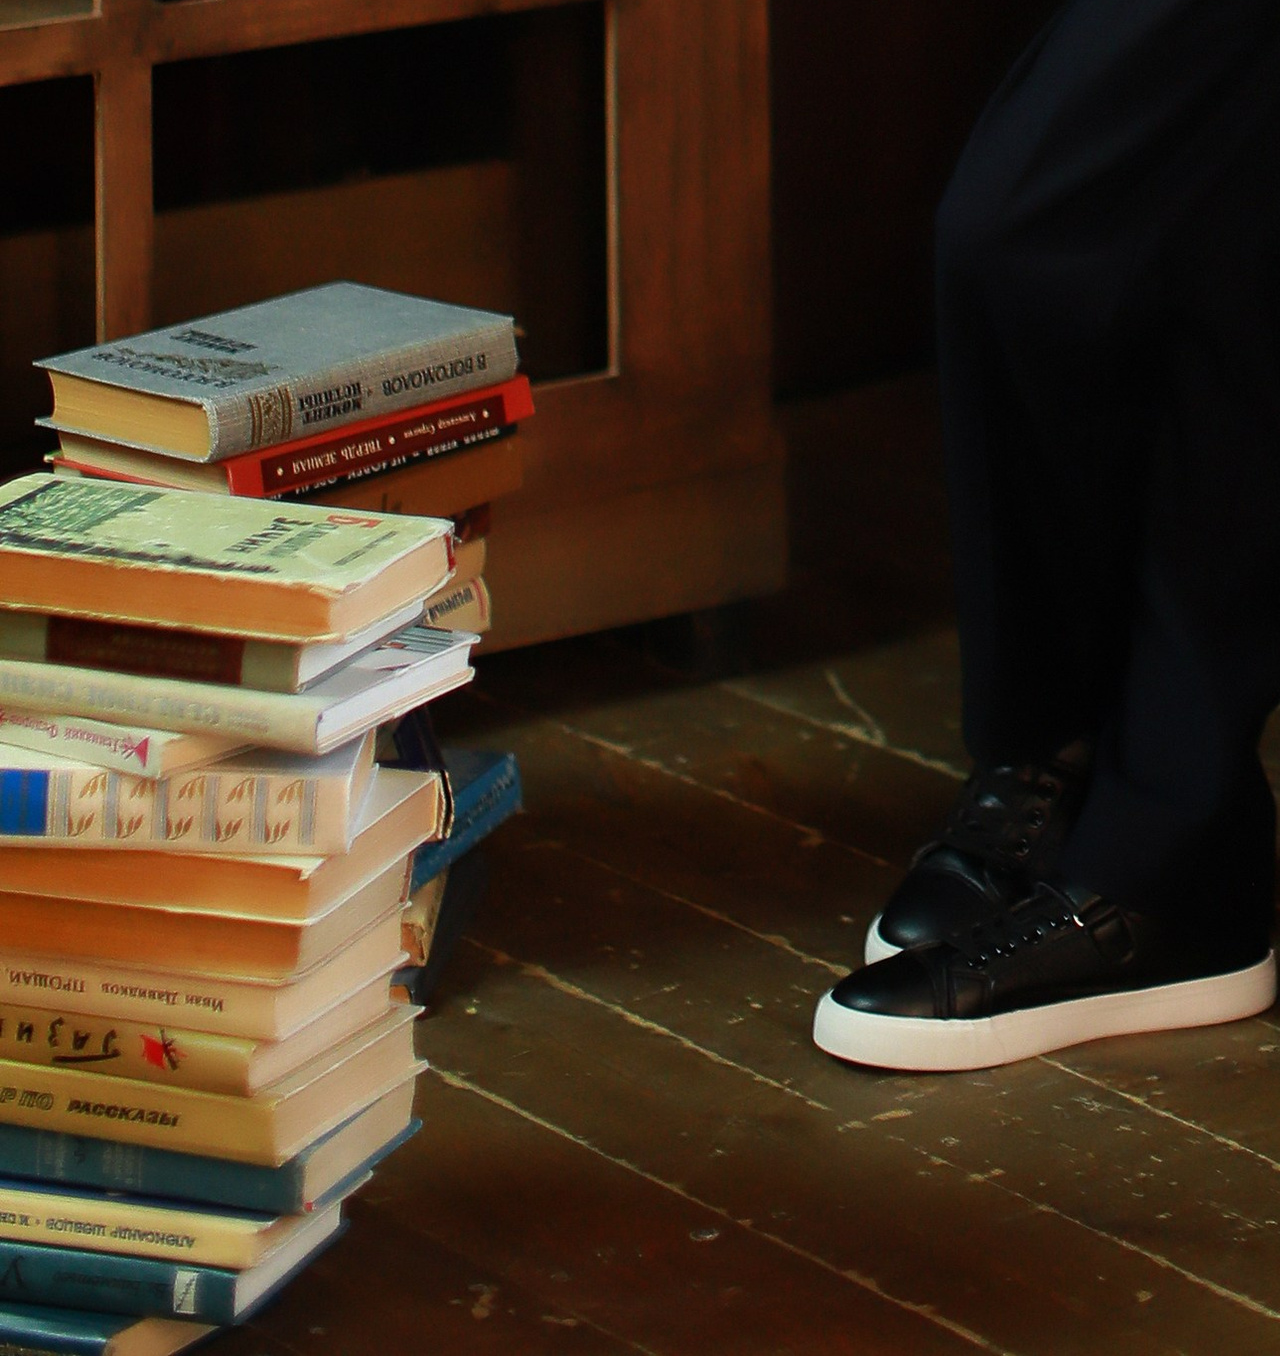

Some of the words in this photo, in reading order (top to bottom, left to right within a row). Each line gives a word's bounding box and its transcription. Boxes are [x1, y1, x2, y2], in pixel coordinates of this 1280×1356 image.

[381, 359, 474, 397] БОГОМОЛОВ
[341, 437, 384, 461] ТВЕРДЬ
[292, 451, 338, 475] ЗЕМНАЯ
[101, 981, 180, 1006] Давидков
[185, 993, 225, 1013] Иван
[0, 1016, 122, 1065] ГАЗИ
[66, 1098, 182, 1128] РАССКАЗЫ
